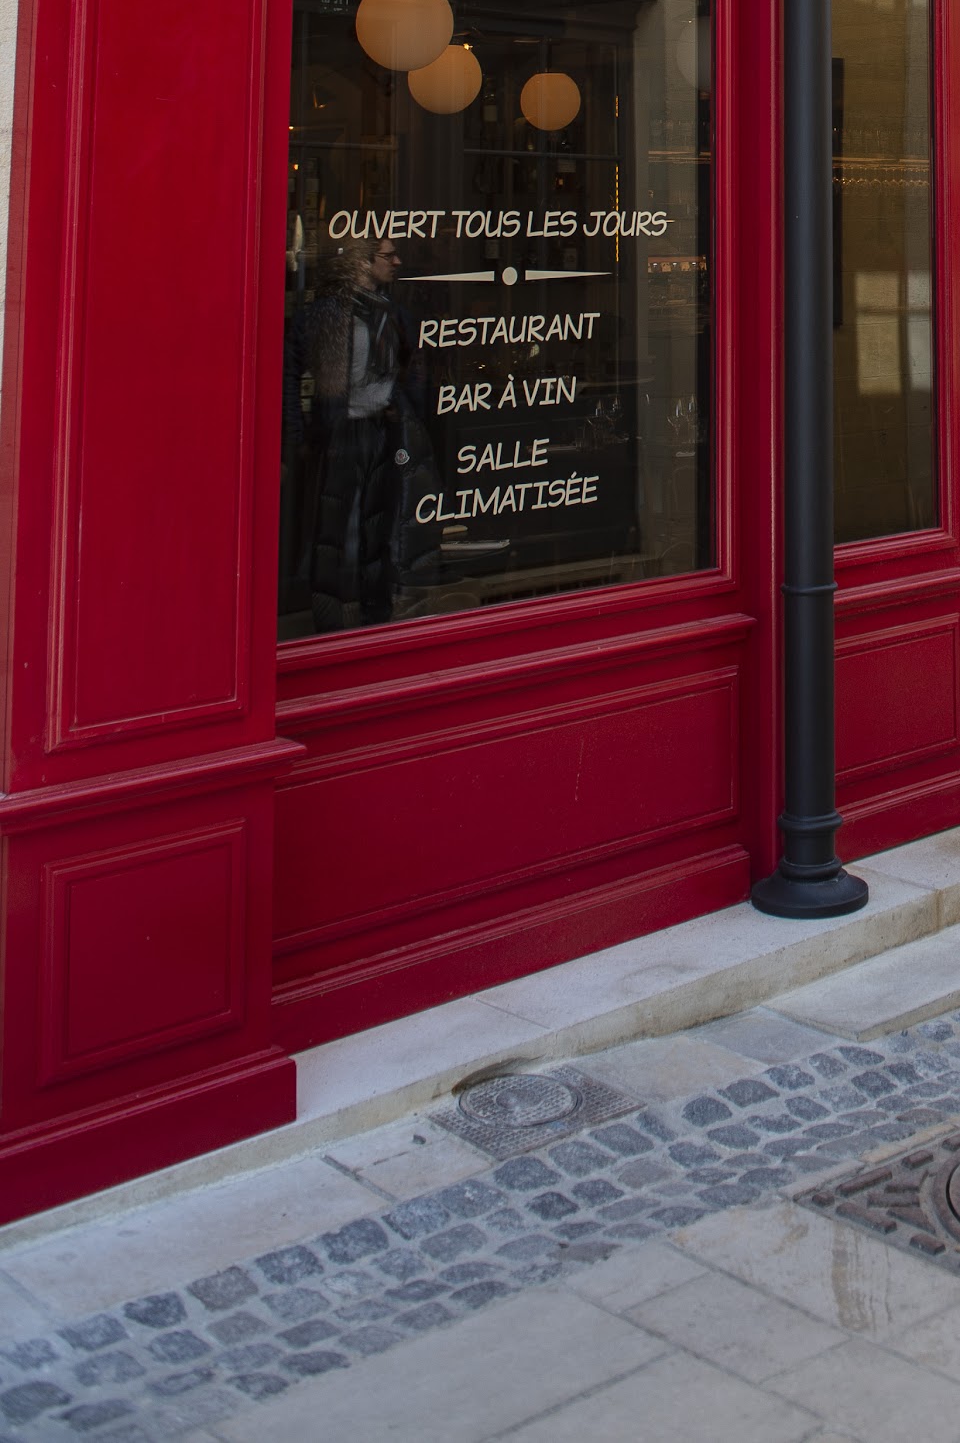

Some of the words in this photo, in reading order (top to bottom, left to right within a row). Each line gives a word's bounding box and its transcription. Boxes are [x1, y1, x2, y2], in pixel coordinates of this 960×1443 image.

[327, 210, 446, 239] OUVERT
[451, 210, 521, 238] TOUS
[526, 211, 577, 237] LES
[583, 211, 668, 237] JOURS
[418, 312, 600, 349] RESTAURANT
[437, 382, 491, 415] BAR
[498, 373, 517, 408] À
[523, 375, 577, 407] VIN
[457, 438, 550, 474] SALLE
[415, 472, 600, 523] CLIMATISÉE
